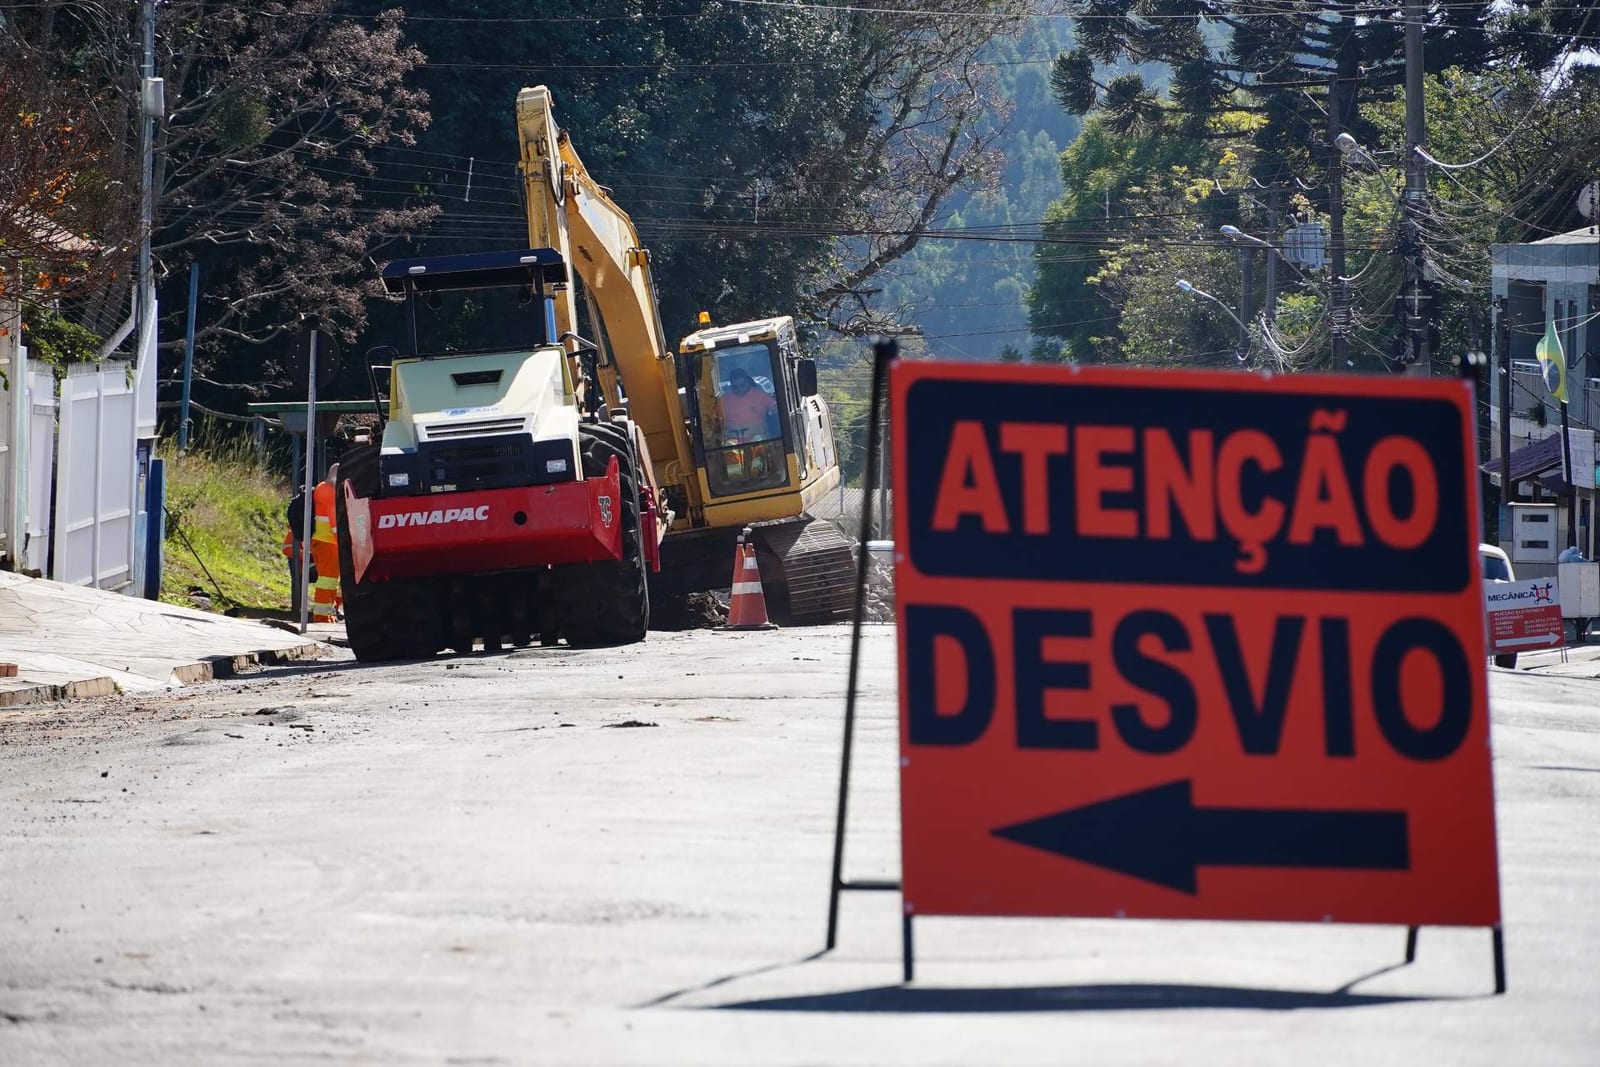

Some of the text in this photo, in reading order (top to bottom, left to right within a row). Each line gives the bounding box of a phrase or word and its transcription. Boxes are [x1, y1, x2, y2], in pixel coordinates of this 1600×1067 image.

[378, 505, 489, 529] DYNAPAC
[932, 409, 1438, 573] ATENÇÃO
[1488, 591, 1535, 602] MECÂNICA
[905, 603, 1472, 762] DESVIO
